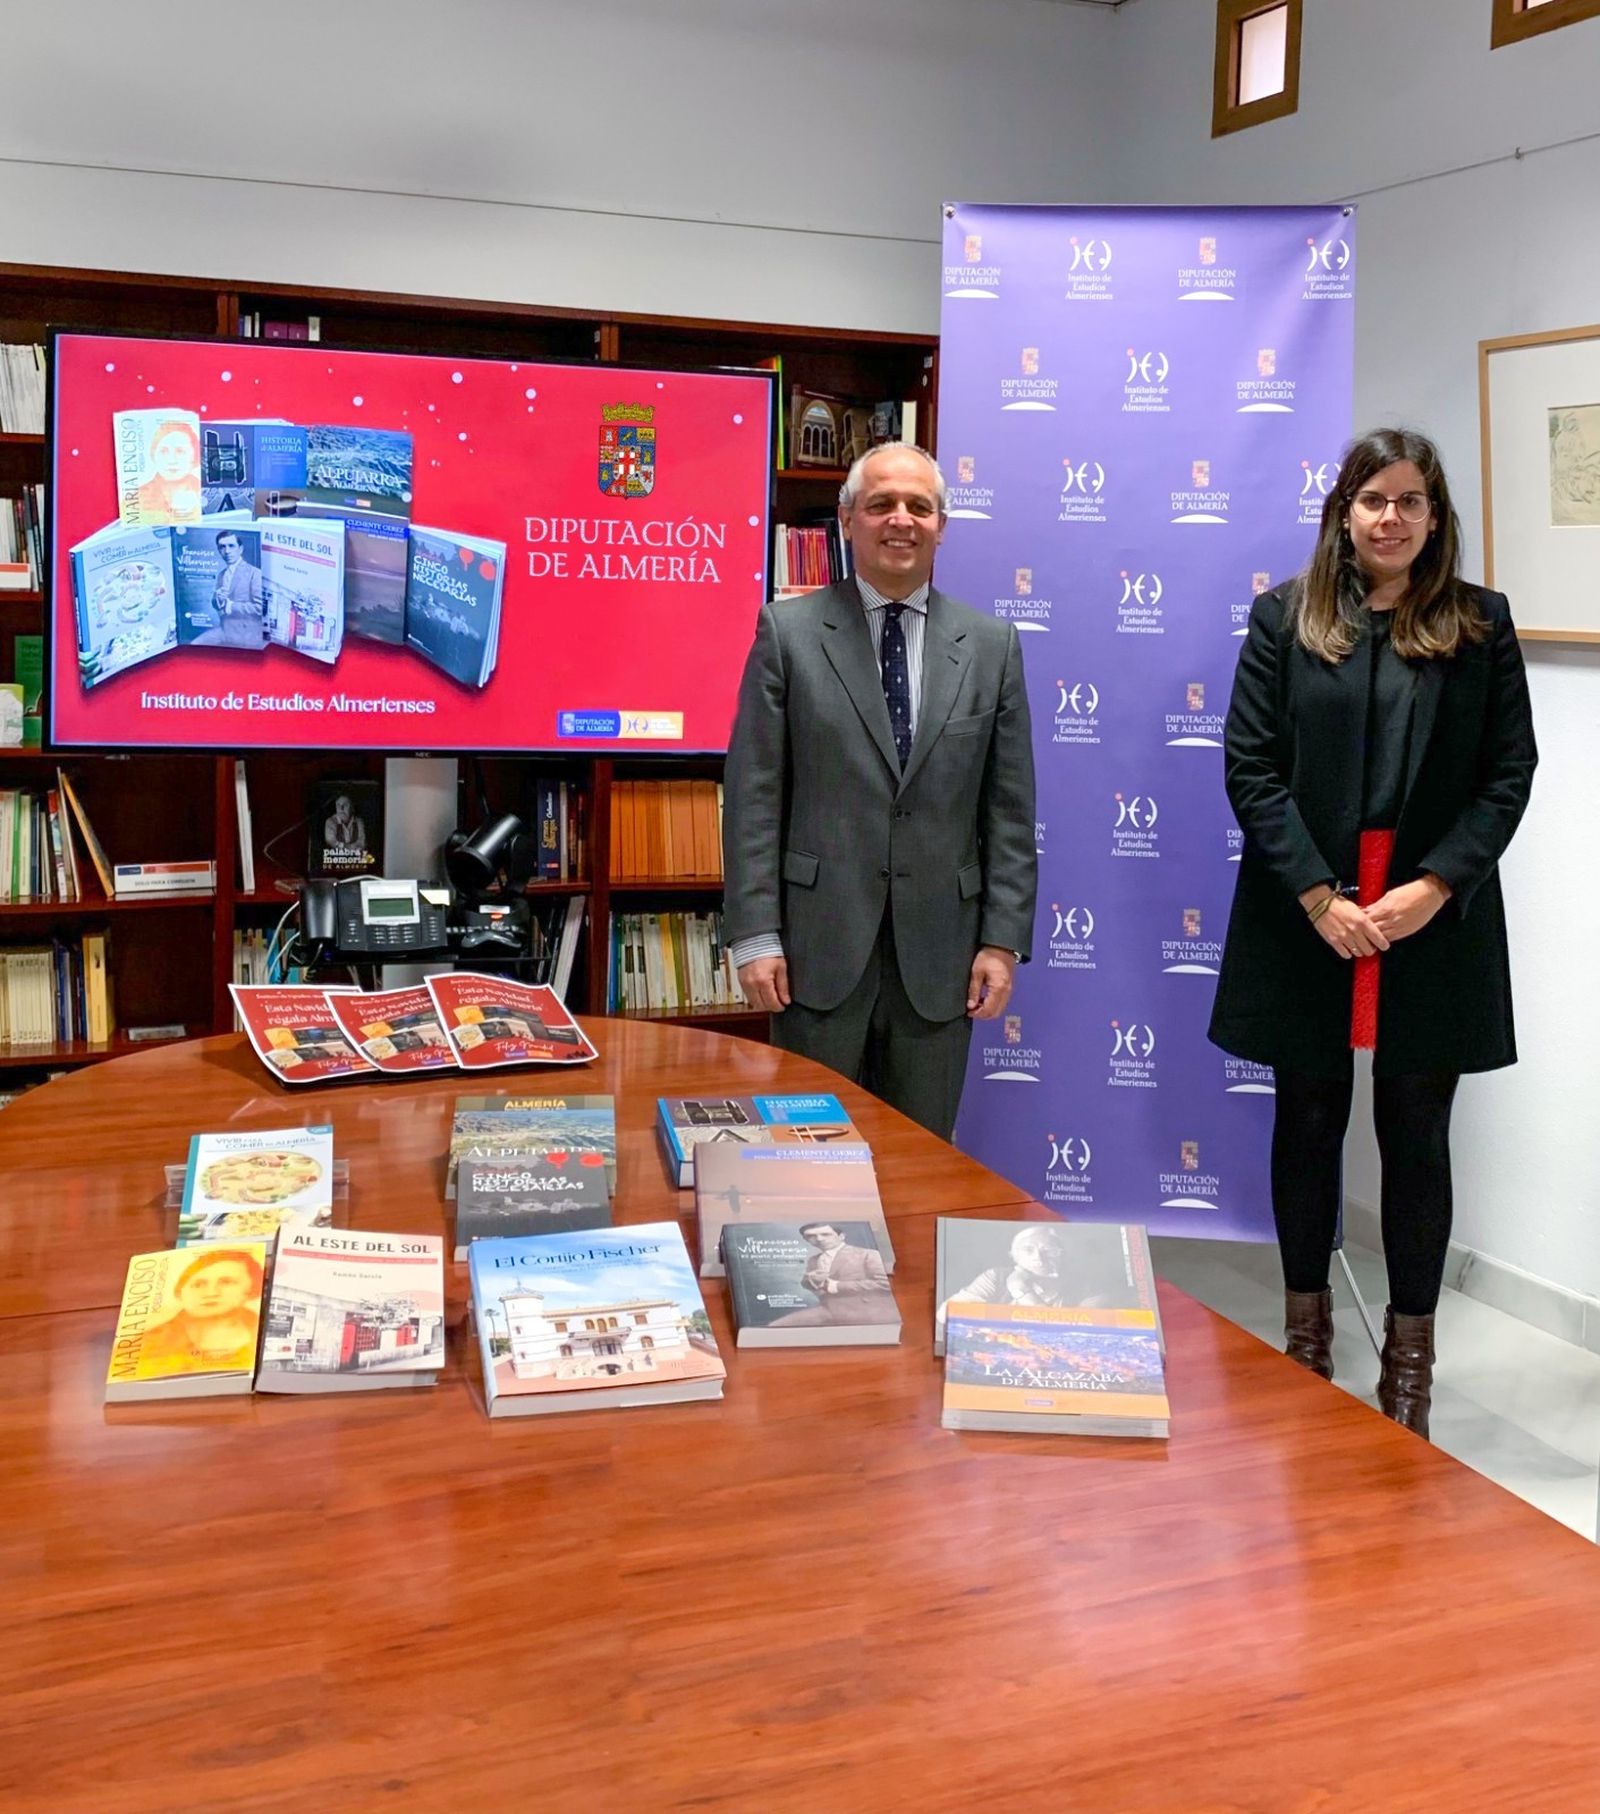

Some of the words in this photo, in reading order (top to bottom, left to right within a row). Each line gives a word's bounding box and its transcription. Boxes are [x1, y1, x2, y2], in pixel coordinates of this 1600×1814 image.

[944, 266, 1000, 276] DIPUTACIÓN
[1178, 269, 1236, 278] DIPUTACIÓN
[945, 276, 958, 284] DE
[960, 276, 1000, 286] ALMERÍA
[1068, 274, 1098, 282] Instituto
[1100, 274, 1112, 282] de
[1304, 273, 1338, 282] Instituto
[1340, 273, 1350, 281] de
[1179, 278, 1192, 288] DE
[1194, 278, 1234, 288] ALMERÍA
[1310, 282, 1344, 290] Estudios
[1066, 292, 1113, 300] Almerienses
[1302, 291, 1352, 300] Almerienses
[1001, 379, 1058, 388] DIPUTACIÓN
[1236, 380, 1296, 390] DIPUTACIÓN
[1002, 389, 1014, 398] DE
[1016, 388, 1056, 398] ALMERÍA
[1238, 390, 1250, 399] DE
[1252, 390, 1294, 400] ALMERÍA
[121, 418, 138, 473] ENCISO
[261, 436, 302, 445] HISTORIA
[316, 464, 402, 488] ALPUJARRA
[1060, 494, 1092, 504] Instituto
[1094, 496, 1104, 504] de
[1171, 492, 1230, 501] DIPUTACIÓN
[1066, 504, 1098, 512] Estudios
[1172, 502, 1184, 510] DE
[1186, 500, 1228, 510] ALMERÍA
[1058, 513, 1106, 522] Almerienses
[525, 516, 726, 548] DIPUTACIÓN
[264, 532, 276, 542] AL
[278, 534, 296, 546] ESTE
[300, 538, 314, 550] DEL
[317, 543, 333, 556] SOL
[414, 555, 448, 574] CINCO
[528, 552, 569, 578] DE
[577, 551, 722, 584] ALMERÍA
[414, 563, 468, 593] HISTORIAS
[413, 572, 477, 607] NECESARIAS
[995, 600, 1052, 609] DIPUTACIÓN
[996, 609, 1008, 618] DE
[1010, 608, 1050, 618] ALMERÍA
[1118, 606, 1152, 616] Instituto
[1152, 608, 1162, 616] de
[1124, 616, 1156, 624] Estudios
[1232, 614, 1244, 622] DE
[1116, 624, 1164, 634] Almerienses
[141, 692, 218, 710] Instituto
[221, 692, 244, 710] de
[248, 692, 324, 712] Estudios
[327, 694, 436, 714] Almerienses
[1054, 716, 1087, 725] Instituto
[1088, 717, 1098, 726] de
[1166, 714, 1224, 724] DIPUTACIÓN
[1060, 726, 1092, 734] Estudios
[1166, 724, 1178, 733] DE
[1180, 724, 1223, 734] ALMERÍA
[1052, 735, 1100, 744] Almerienses
[1112, 830, 1146, 839] Instituto
[1148, 830, 1158, 840] de
[1118, 840, 1152, 848] Estudios
[1228, 840, 1240, 848] DE
[323, 848, 361, 857] palabra
[1110, 848, 1160, 858] Almerienses
[323, 856, 368, 864] memoria
[1050, 940, 1082, 950] Instituto
[1084, 942, 1095, 951] de
[1162, 940, 1222, 951] DIPUTACIÓN
[1056, 950, 1088, 960] Estudios
[1163, 951, 1176, 960] DE
[1178, 951, 1220, 961] ALMERÍA
[1048, 960, 1096, 969] Almerienses
[983, 1048, 1041, 1058] DIPUTACIÓN
[984, 1058, 996, 1066] DE
[999, 1058, 1040, 1068] ALMERÍA
[1110, 1058, 1143, 1068] Instituto
[1145, 1060, 1155, 1070] de
[1115, 1068, 1150, 1078] Estudios
[1226, 1070, 1238, 1078] DE
[1240, 1070, 1275, 1080] ALMER
[1107, 1078, 1157, 1088] Almerienses
[505, 1100, 566, 1109] ALMERÍA
[472, 1172, 532, 1180] CINCO
[1046, 1172, 1080, 1182] Instituto
[1081, 1174, 1092, 1184] de
[1160, 1174, 1220, 1185] DIPUTACIÓN
[472, 1177, 567, 1187] HISTORIAS
[472, 1182, 584, 1192] NECESARIAS
[1052, 1182, 1085, 1192] Estudios
[1160, 1184, 1173, 1193] DE
[1176, 1185, 1218, 1196] ALMERÍA
[1044, 1192, 1093, 1202] Almerienses
[294, 1236, 314, 1246] AL
[320, 1238, 360, 1250] ESTE
[366, 1242, 395, 1252] DEL
[401, 1243, 432, 1254] SOL
[495, 1256, 516, 1269] El
[520, 1251, 586, 1267] Cortijo
[589, 1244, 660, 1260] Fischer
[124, 1259, 158, 1317] ENCISO
[112, 1320, 146, 1378] MARÍA
[984, 1364, 1010, 1378] LA
[1018, 1366, 1124, 1383] ALCAZABA
[1002, 1377, 1024, 1386] DE
[1029, 1376, 1108, 1390] ALMERÍA
